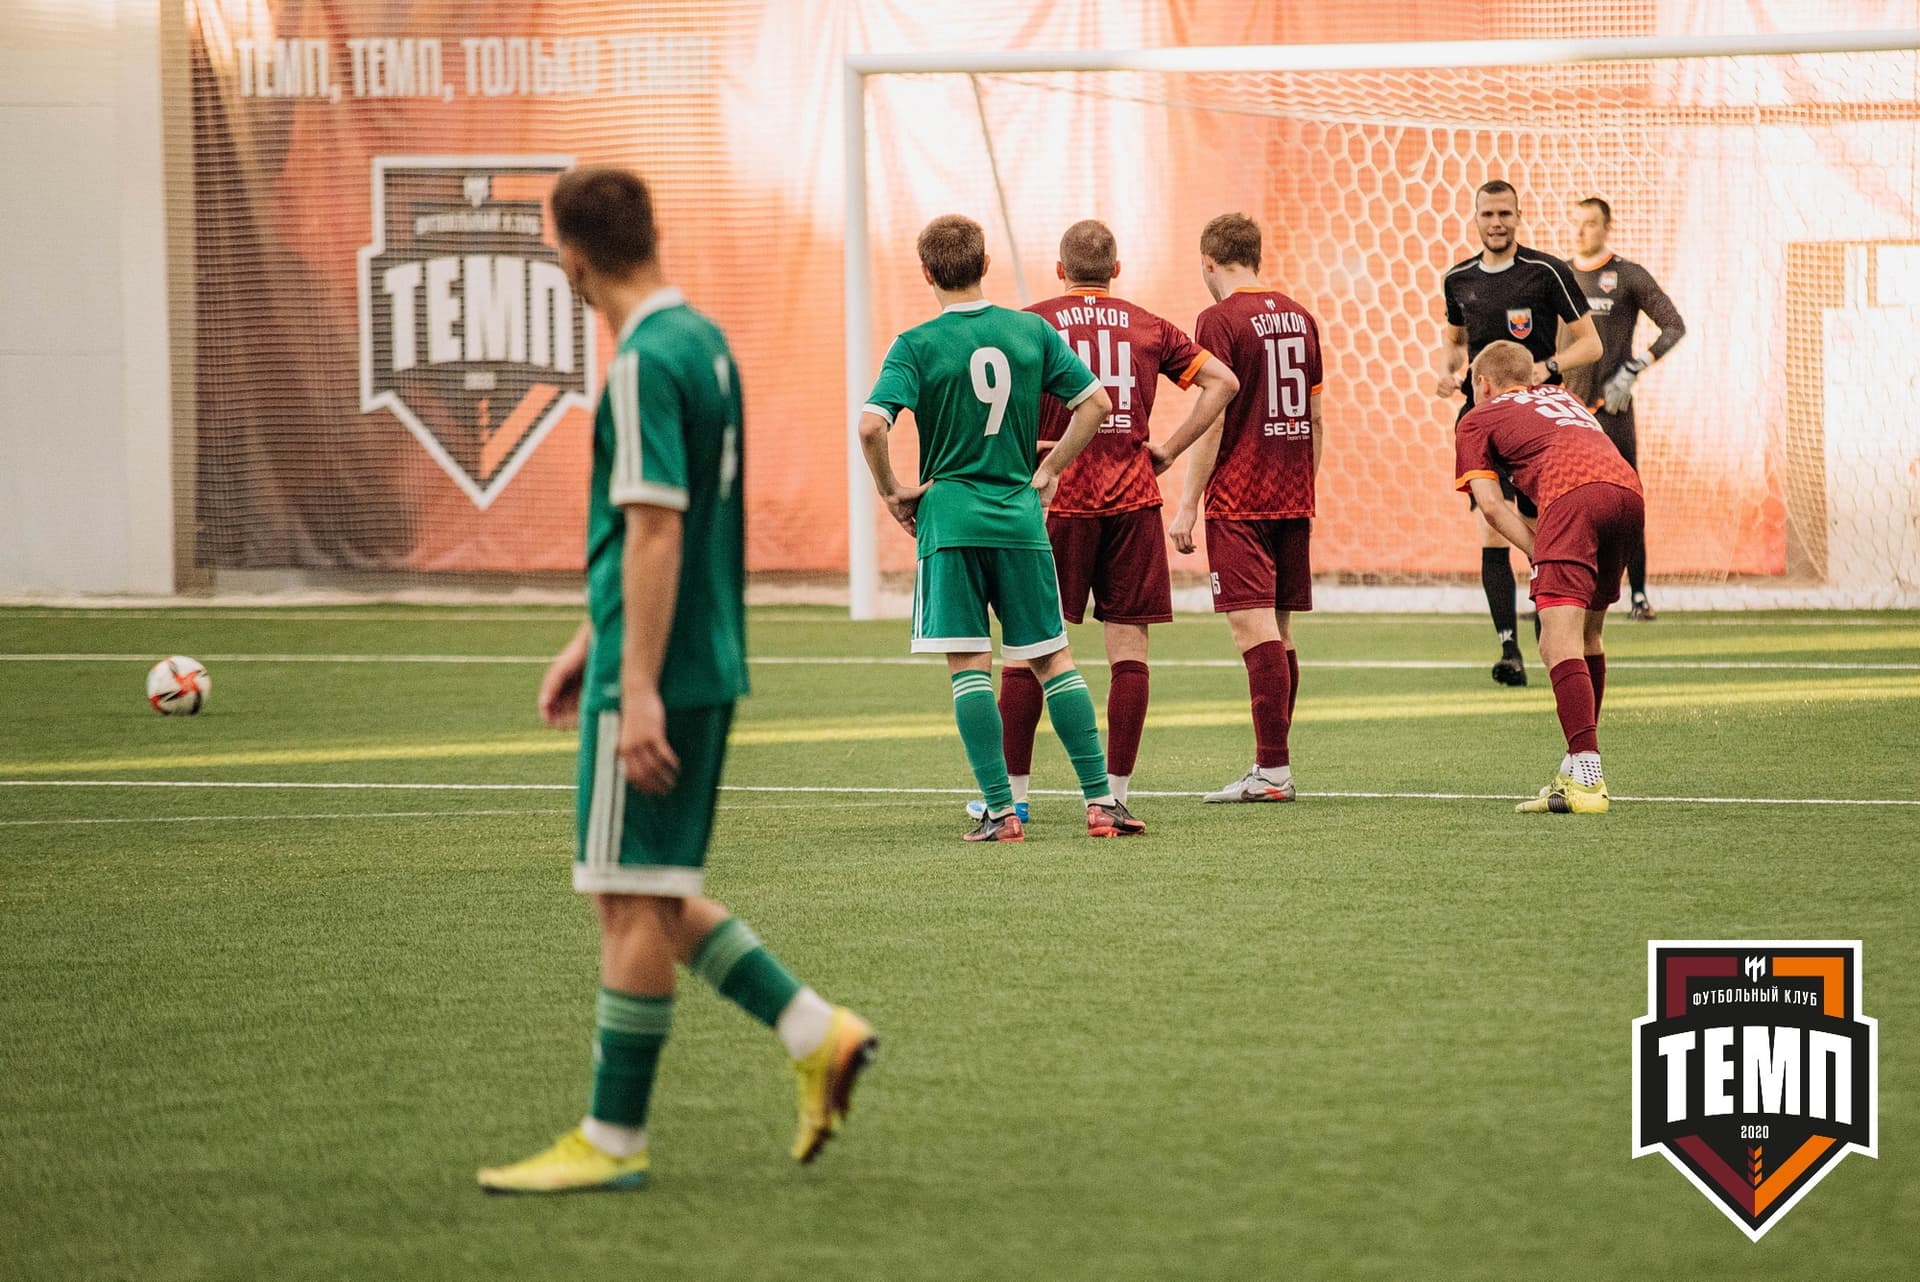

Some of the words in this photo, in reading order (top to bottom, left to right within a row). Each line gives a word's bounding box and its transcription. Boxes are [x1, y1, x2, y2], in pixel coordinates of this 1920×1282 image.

[236, 38, 341, 103] ТЕМП,
[346, 37, 454, 103] ТЕМП,
[383, 254, 575, 374] ТЕМП
[1056, 306, 1130, 329] МАРКОВ
[969, 346, 1012, 437] 9
[1264, 336, 1307, 418] 15
[1264, 421, 1310, 436] SEUS
